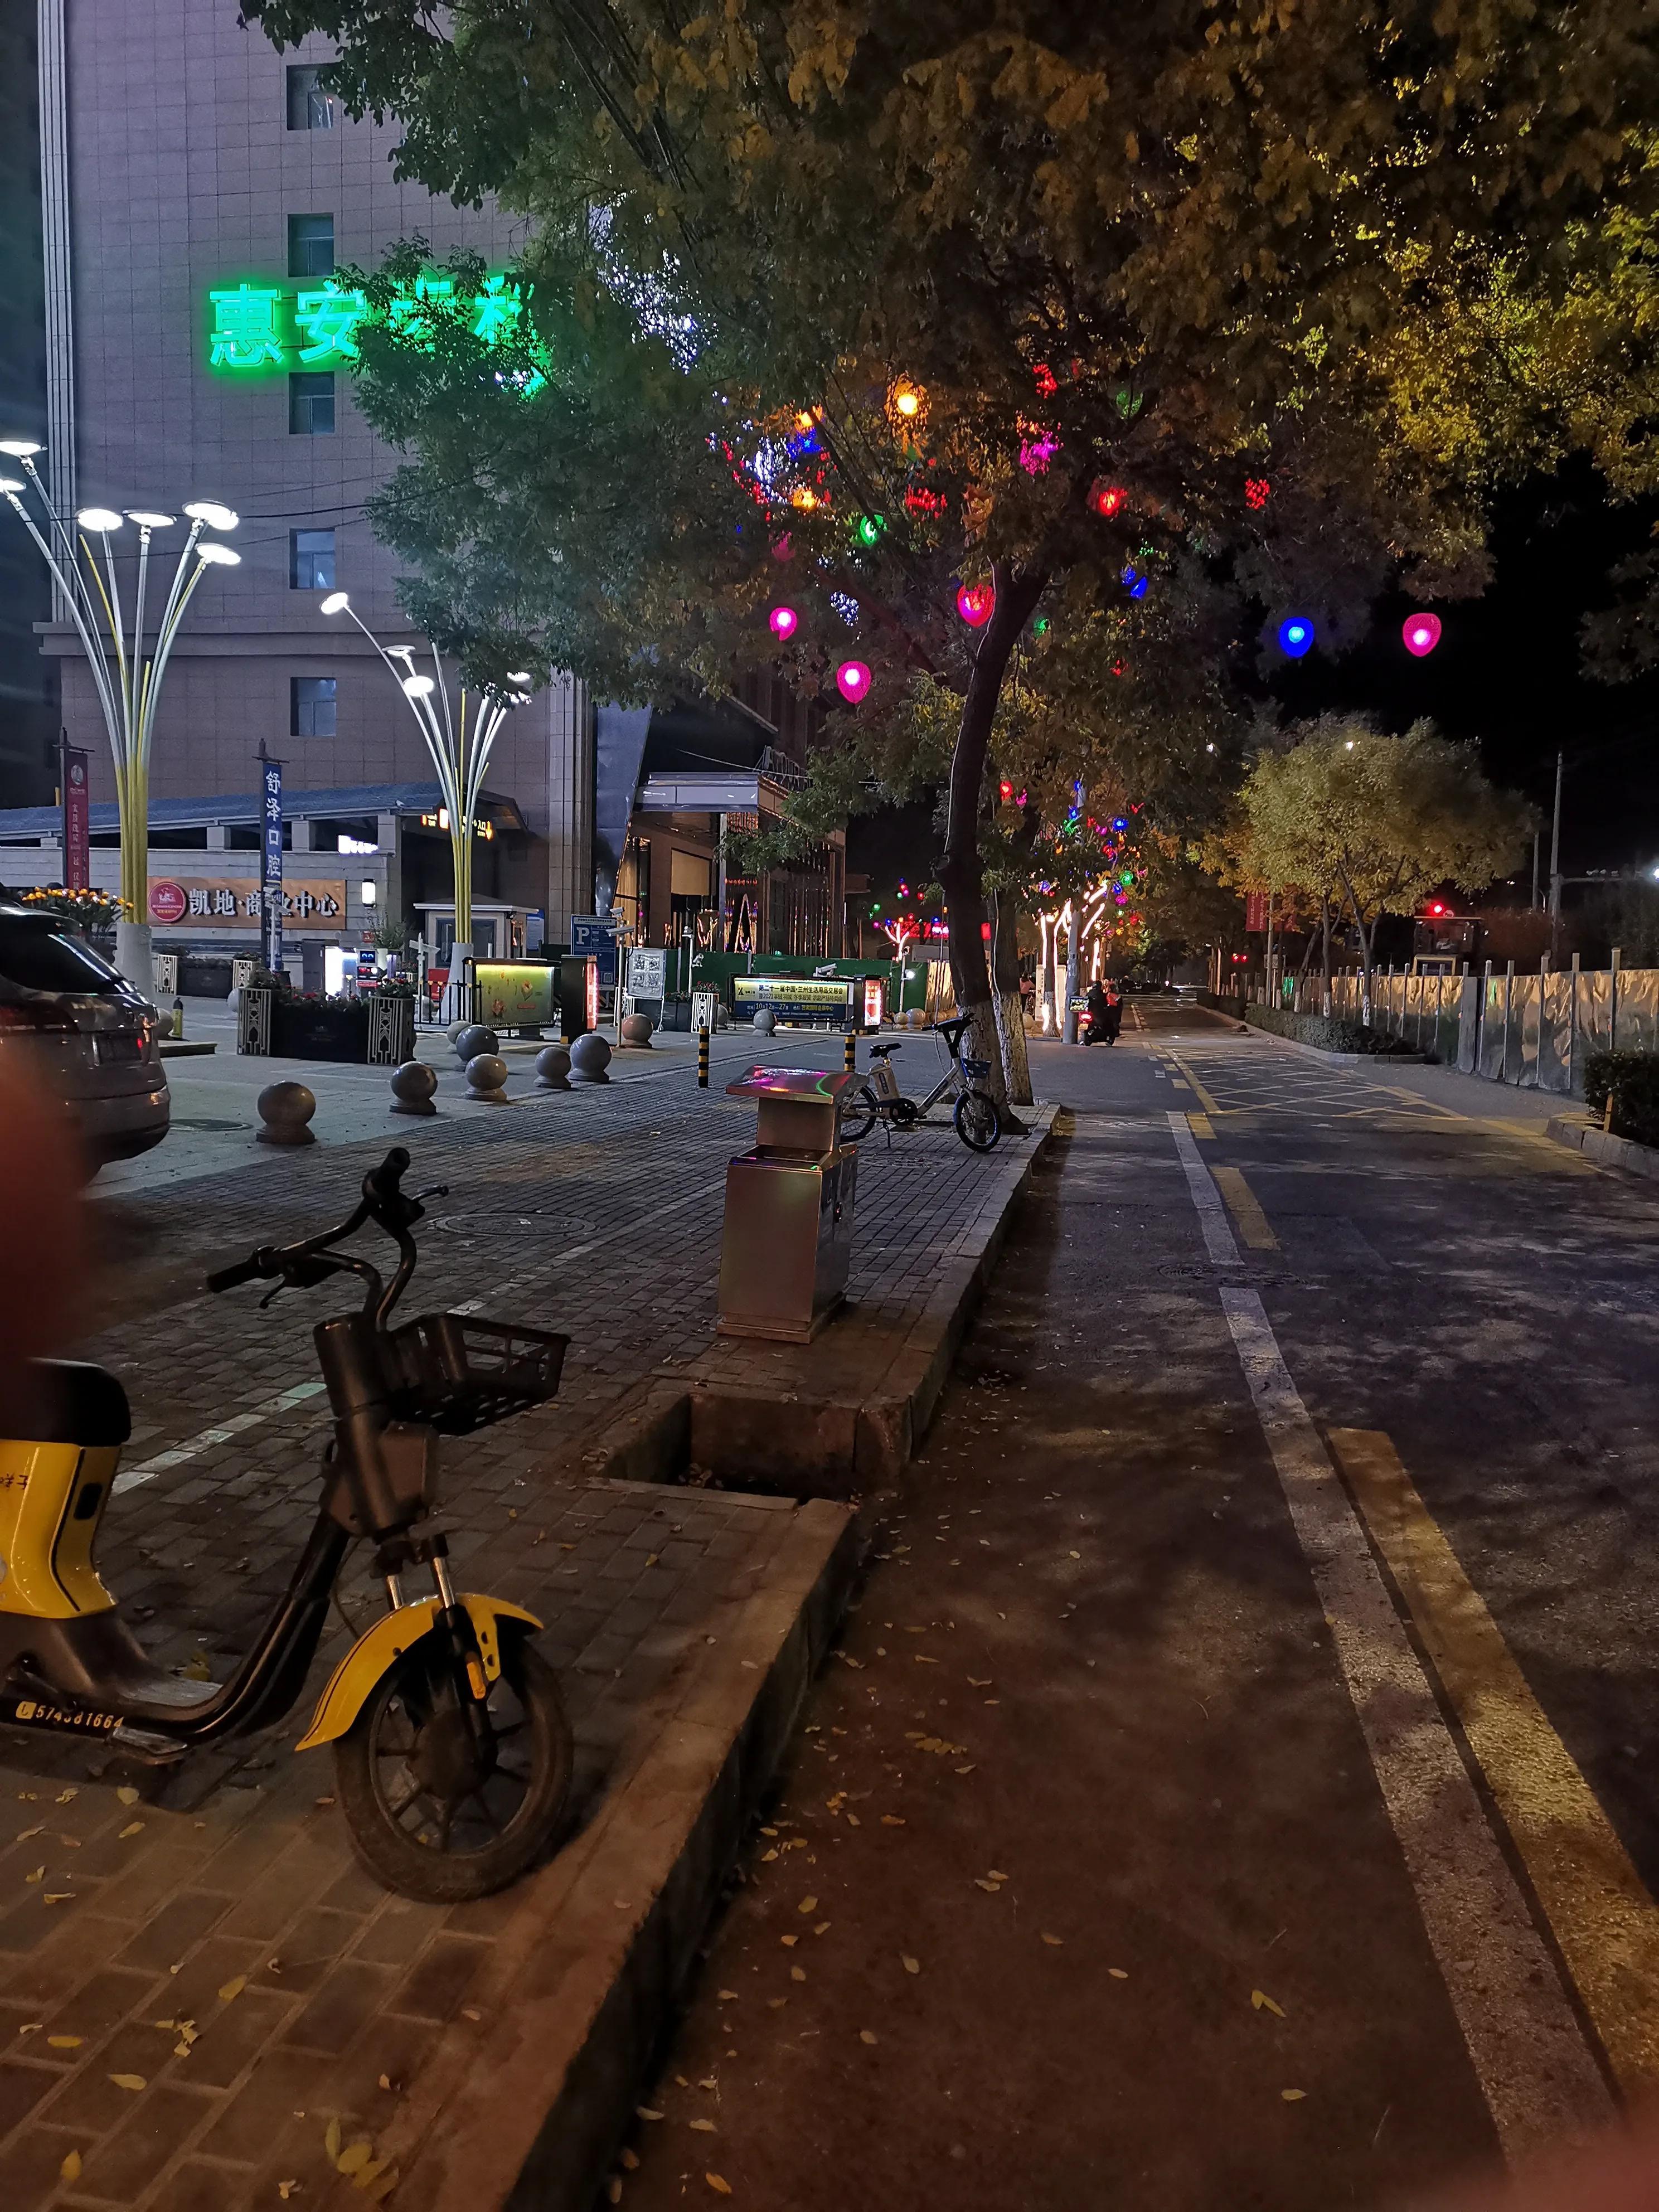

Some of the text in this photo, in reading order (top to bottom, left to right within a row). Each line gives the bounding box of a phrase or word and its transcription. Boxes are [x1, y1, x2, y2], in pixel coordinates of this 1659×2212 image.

[265, 770, 280, 876] 舒泽口腔
[576, 926, 590, 945] P
